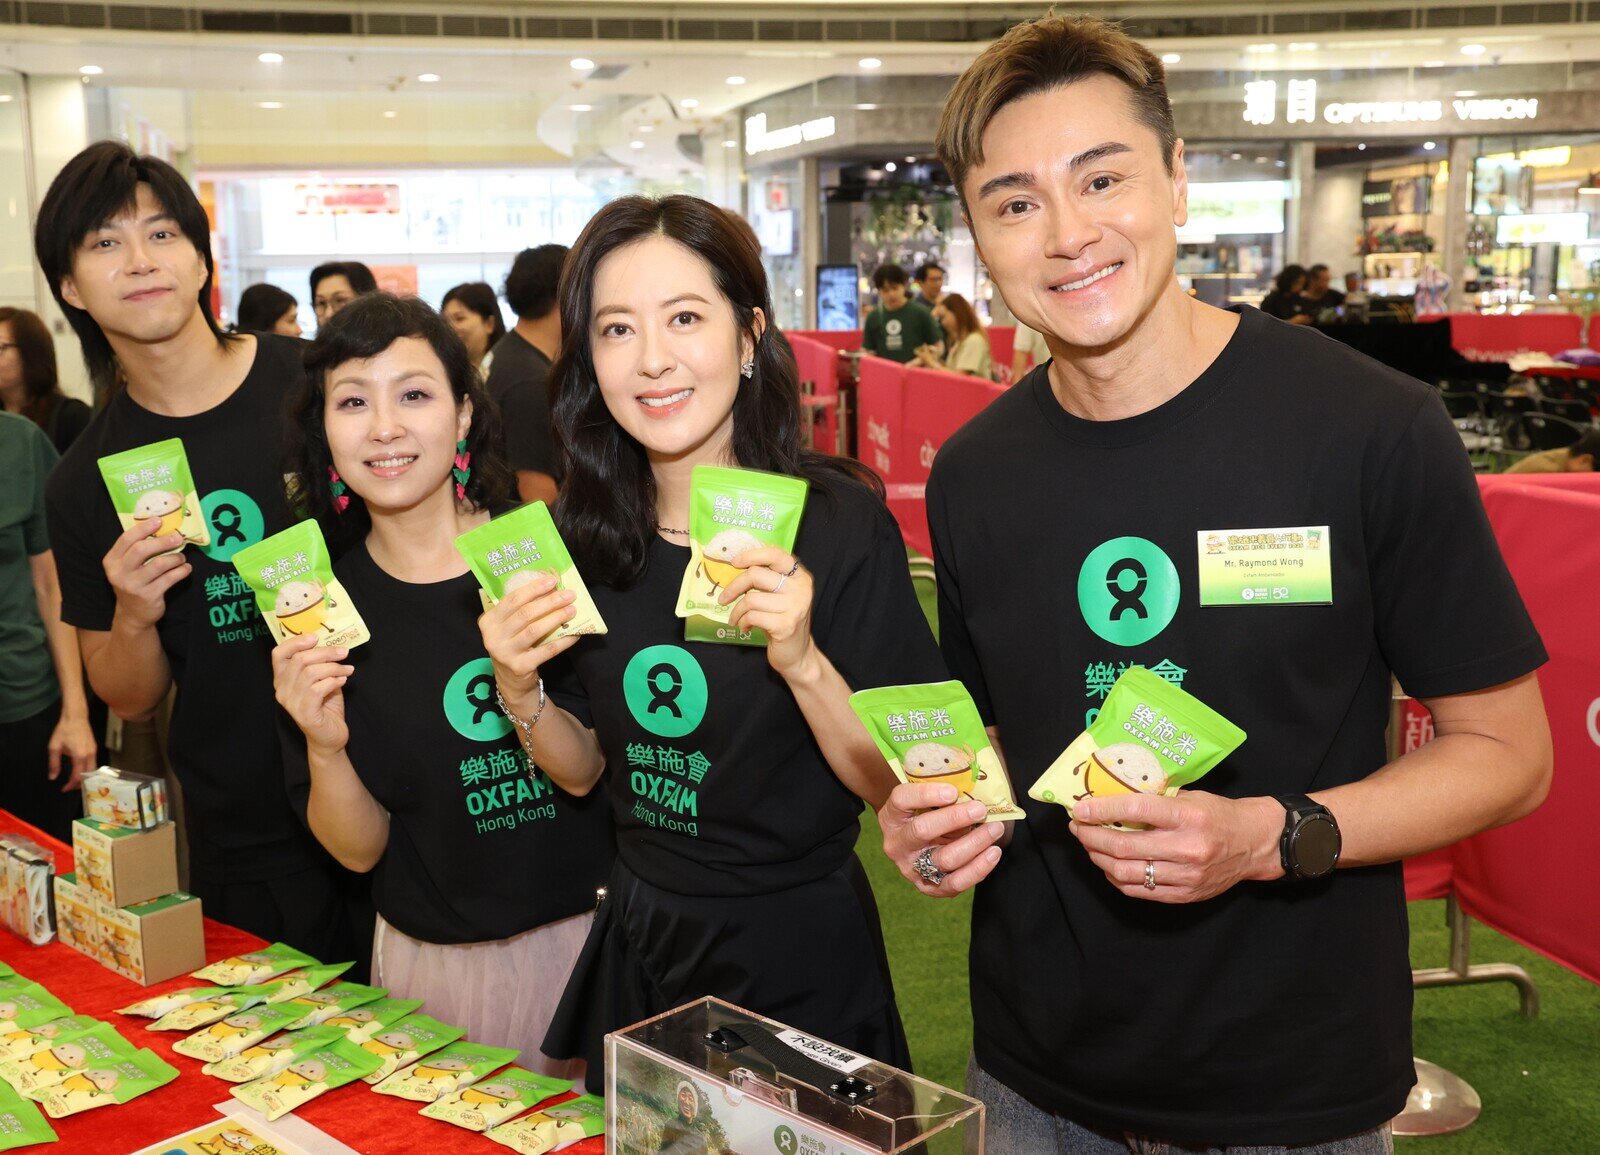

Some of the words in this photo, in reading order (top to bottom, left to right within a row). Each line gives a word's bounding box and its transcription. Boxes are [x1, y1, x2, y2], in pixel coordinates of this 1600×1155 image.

[123, 464, 171, 486] 樂施米
[128, 483, 155, 494] OXFAM
[157, 477, 173, 487] RICE
[714, 495, 775, 520] 樂施米
[712, 515, 747, 528] OXFAM
[750, 522, 774, 532] RICE
[260, 552, 308, 581] 樂施米
[487, 536, 537, 568] 樂施米
[493, 563, 521, 577] OXFAM
[523, 552, 542, 565] RICE
[1224, 560, 1237, 568] Mr.
[1239, 559, 1277, 568] Raymond
[1280, 558, 1304, 567] Wong
[204, 572, 255, 601] 樂施
[265, 574, 292, 589] OXFAM
[293, 565, 311, 577] RICE
[209, 599, 262, 628] OXF
[217, 628, 254, 644] Hong
[887, 708, 951, 733] 樂施米
[893, 733, 929, 742] OXFAM
[932, 727, 956, 738] RICE
[1130, 702, 1198, 756] 樂施米
[1122, 722, 1161, 751] OXFAM
[1161, 746, 1187, 767] RICE
[625, 742, 712, 785] 樂施會
[465, 778, 554, 816] OXFAM
[631, 770, 698, 817] OXFAM
[476, 814, 516, 834] Hong
[517, 803, 556, 823] Kong
[631, 800, 656, 827] Hong
[660, 812, 698, 837] Kong
